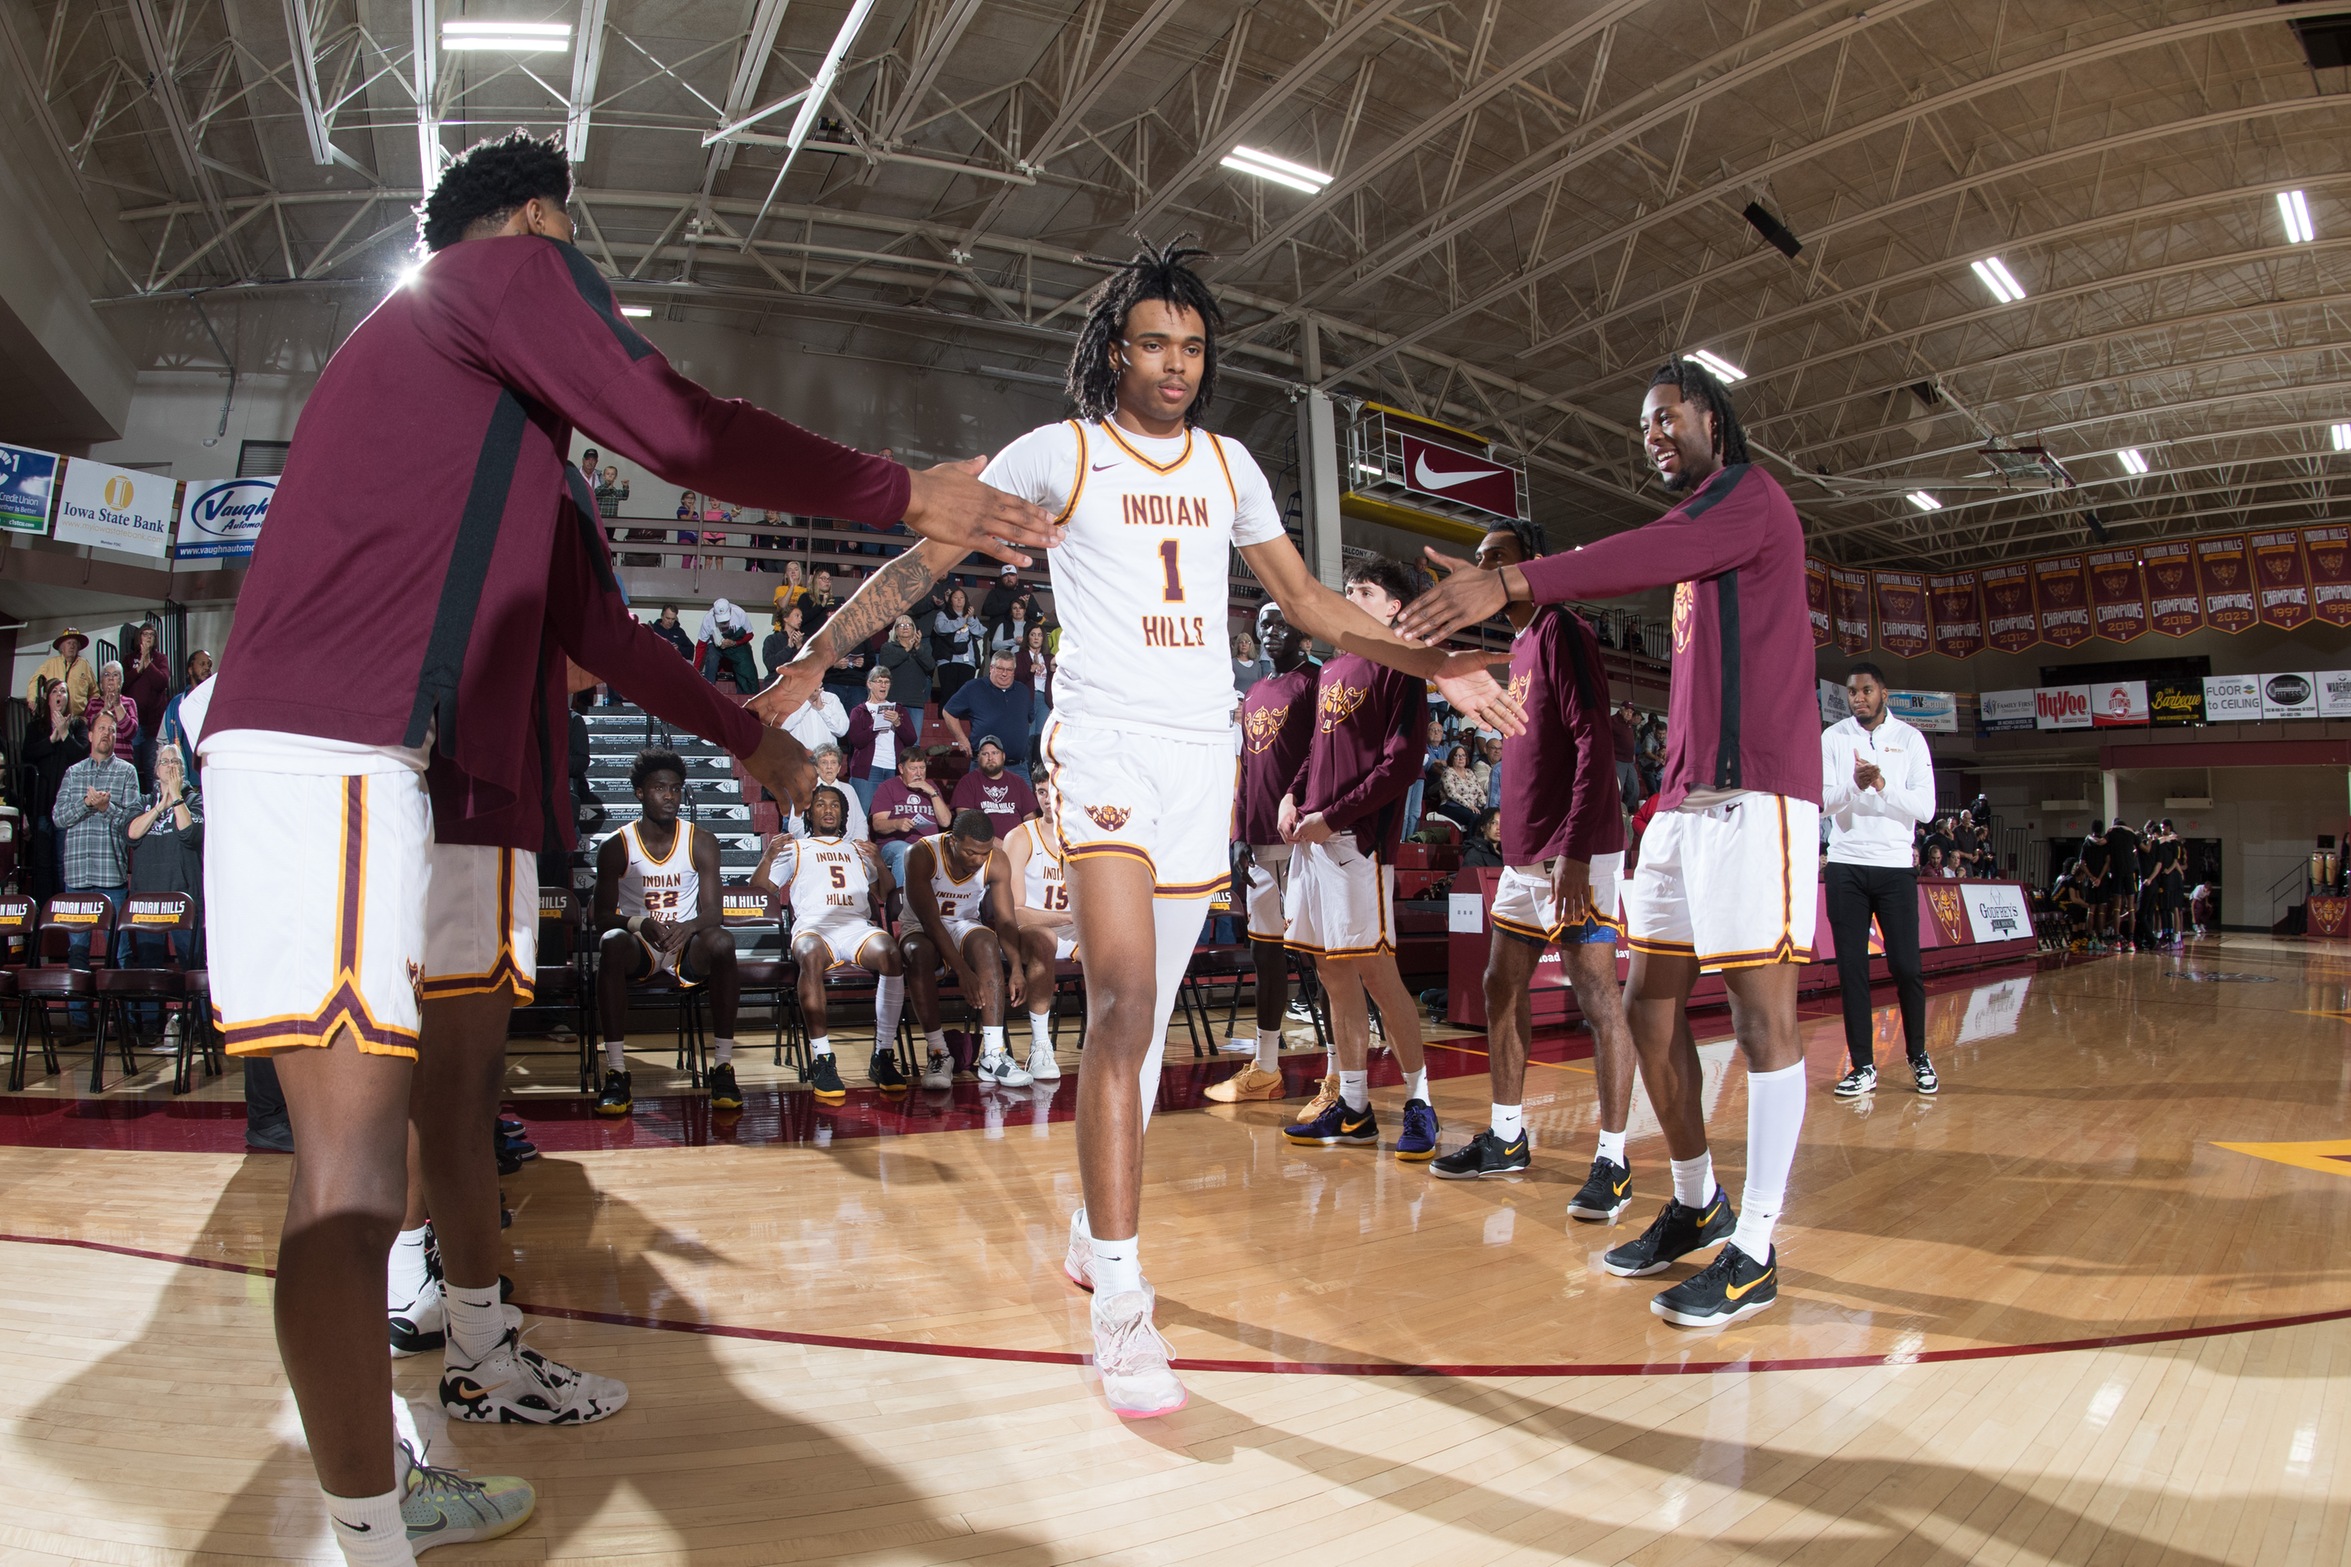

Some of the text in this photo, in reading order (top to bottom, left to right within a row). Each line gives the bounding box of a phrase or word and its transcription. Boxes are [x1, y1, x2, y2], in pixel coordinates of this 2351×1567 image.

[19, 494, 39, 507] Union
[0, 503, 14, 512] ether
[20, 506, 37, 515] Better
[1122, 494, 1210, 528] INDIAN
[63, 501, 165, 533] Iowa State Bank
[2251, 534, 2276, 548] INDIAN
[2276, 532, 2297, 545] HILLS
[2303, 527, 2349, 543] INDIAN HILLS
[2143, 545, 2168, 559] INDIAN
[2168, 543, 2190, 556] HILLS
[2198, 541, 2223, 554] INDIAN
[2223, 538, 2243, 551] HILLS
[2089, 550, 2135, 566] INDIAN HILLS
[1158, 538, 1186, 603] 1
[1814, 562, 1826, 575] HILLS
[2035, 560, 2060, 574] INDIAN
[2060, 557, 2081, 571] HILLS
[1845, 572, 1866, 585] HILLS
[1876, 573, 1922, 587] INDIAN HILLS
[1982, 565, 2027, 581] INDIAN HILLS
[1930, 576, 1955, 588] INDIAN
[2206, 593, 2253, 614] CHAMPIONS
[2261, 587, 2308, 609] CHAMPIONS
[2096, 602, 2144, 623] CHAMPIONS
[2151, 597, 2199, 618] CHAMPIONS
[2272, 606, 2301, 618] 1997
[2042, 608, 2089, 629] CHAMPIONS
[2162, 615, 2193, 626] 2018
[2216, 611, 2249, 623] 2023
[1142, 615, 1206, 647] HILLS
[1882, 621, 1927, 640] CHAMPIONS
[1935, 622, 1982, 641] CHAMPIONS
[1989, 614, 2035, 636] CHAMPIONS
[2052, 626, 2082, 638] 2014
[2107, 620, 2137, 632] 2015
[1889, 638, 1922, 648] 2000
[1948, 639, 1973, 649] 2011
[2000, 632, 2029, 644] 2012
[2206, 685, 2241, 697] FLOOR
[1997, 700, 2034, 710] FAMILY FIRST
[2208, 698, 2259, 710] to CEILING
[894, 804, 936, 816] PRIDE
[999, 802, 1015, 810] HILLS
[816, 852, 852, 863] INDIAN
[643, 873, 681, 887] INDIAN
[829, 866, 847, 889] 5
[644, 891, 679, 910] 22
[738, 895, 768, 907] HILLS
[826, 894, 854, 906] HILLS
[1044, 885, 1069, 911] 15
[6, 903, 28, 917] HILLS
[51, 901, 105, 914] INDIAN HILLS
[129, 901, 186, 914] INDIAN HILLS
[940, 900, 957, 916] 2
